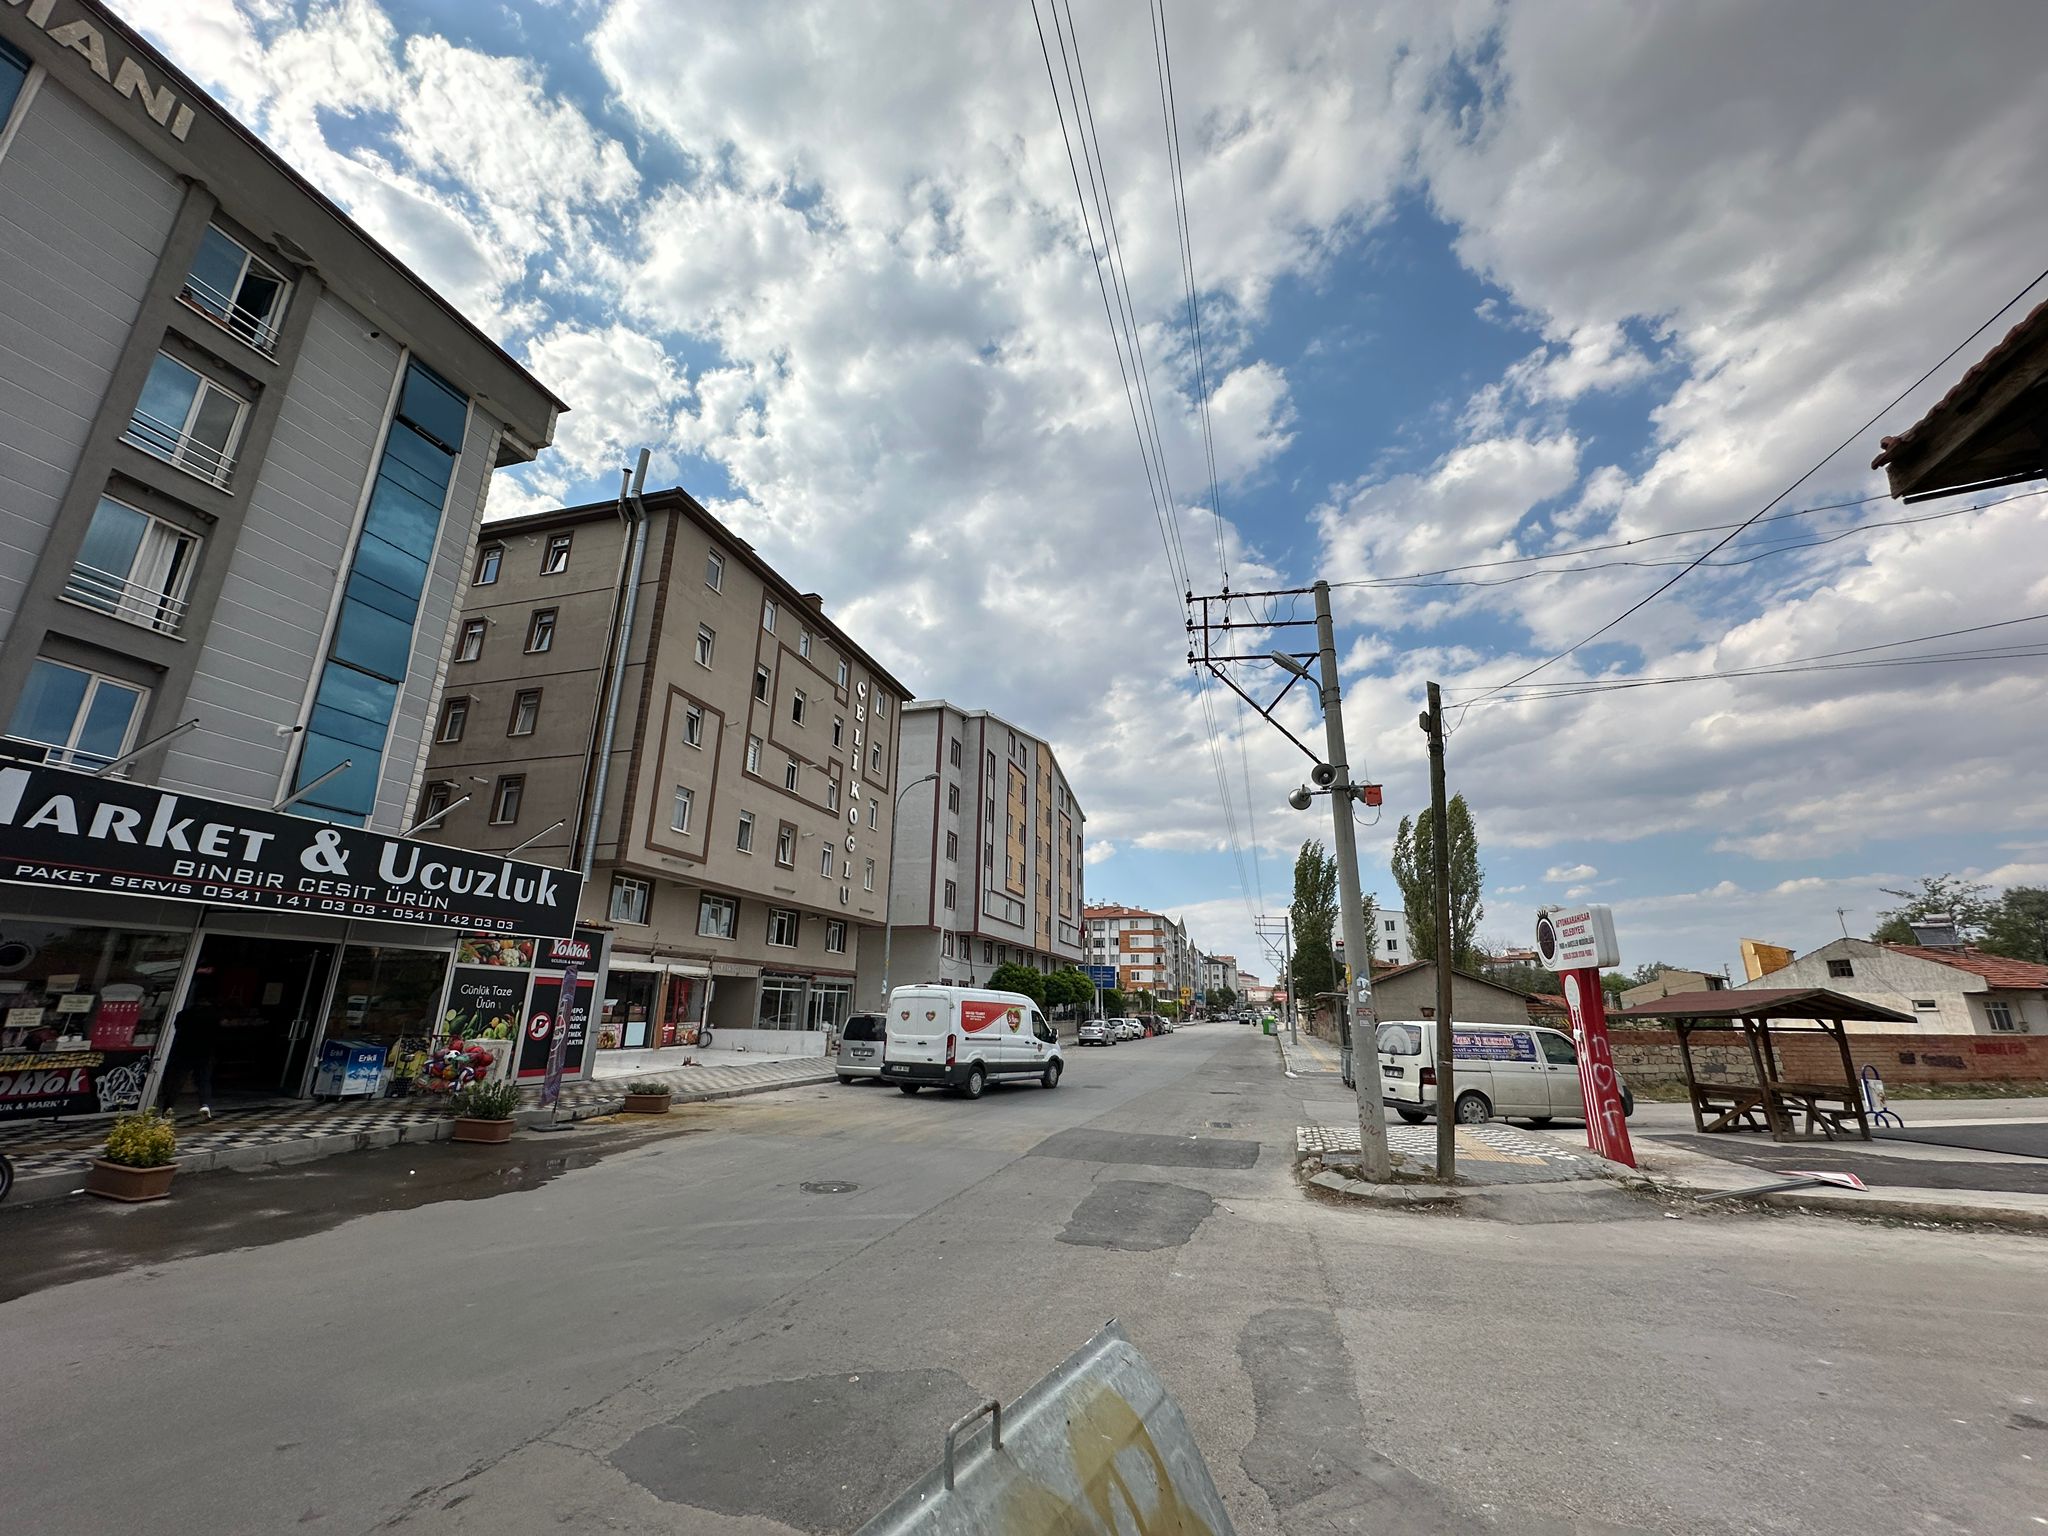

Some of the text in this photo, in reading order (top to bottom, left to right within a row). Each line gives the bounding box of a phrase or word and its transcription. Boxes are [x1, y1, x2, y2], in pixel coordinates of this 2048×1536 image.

[840, 681, 866, 904] ÇELİKOĞLU
[300, 829, 349, 876] &
[378, 841, 558, 906] Ucuzluk
[15, 865, 101, 883] PAKET
[110, 876, 192, 894] SERVIS
[203, 886, 260, 902] 0541
[276, 894, 310, 907] 141
[321, 900, 345, 911] 03
[353, 903, 375, 915] 03
[393, 908, 433, 921] 0541
[443, 913, 469, 925] 142
[474, 918, 492, 928] 03
[497, 920, 513, 930] 03
[386, 886, 449, 910] ÜRÜN
[552, 939, 590, 958] YokYok
[461, 984, 512, 996] Günlük Taze
[476, 996, 495, 1009] Ürün
